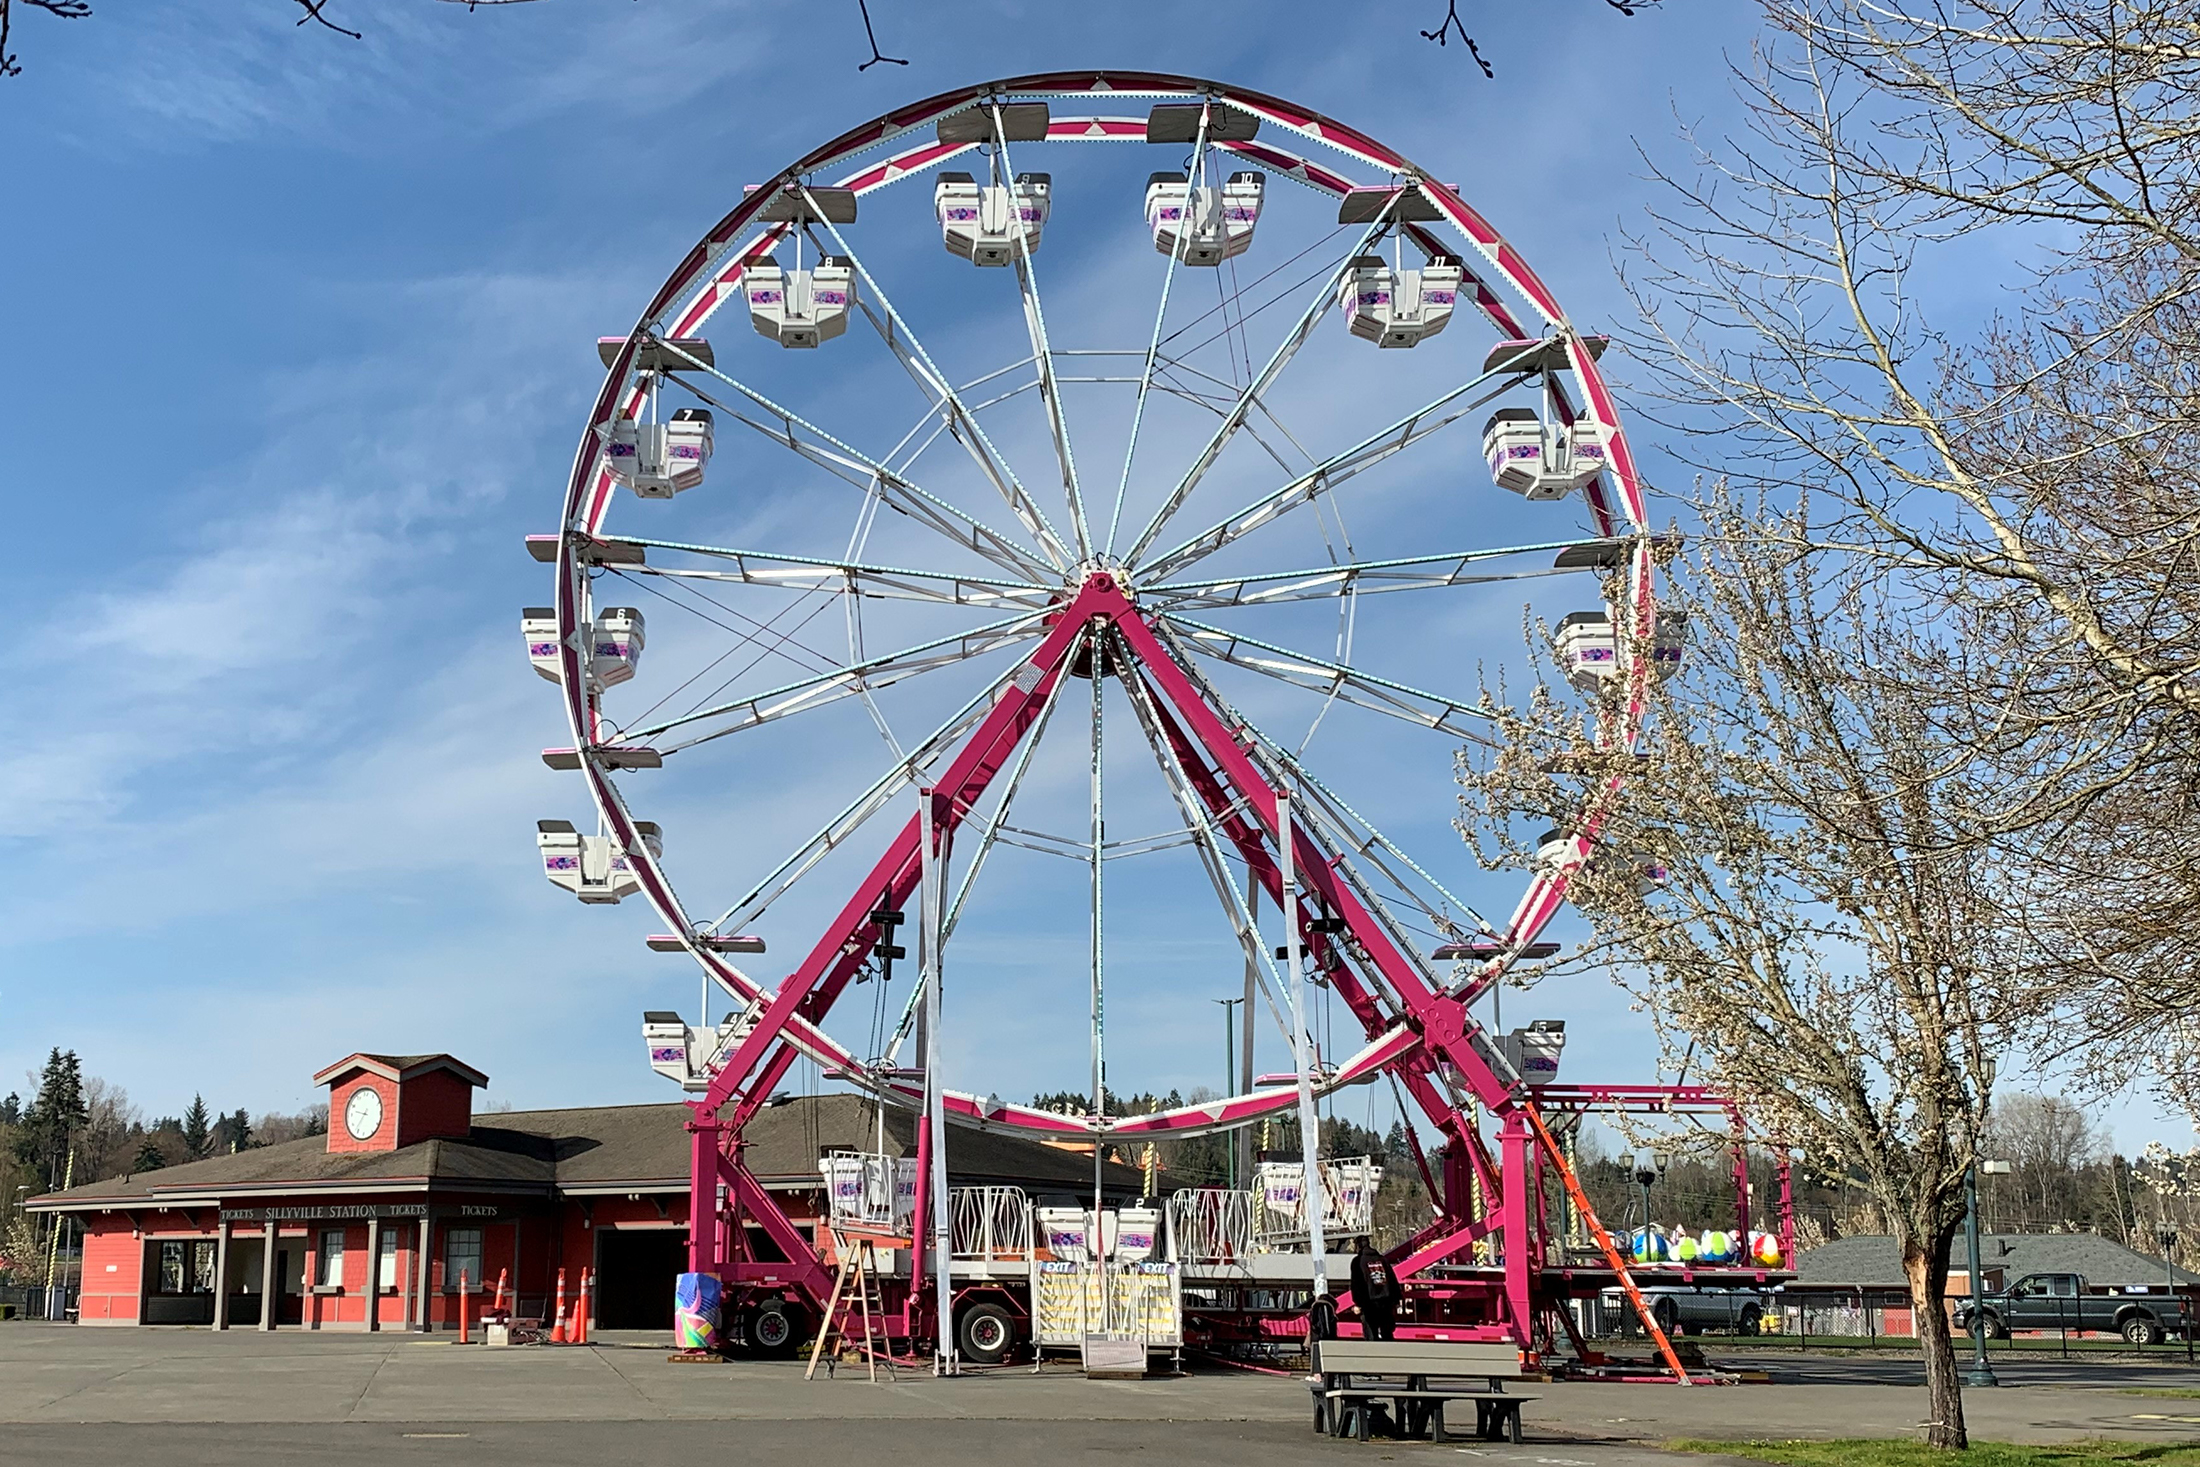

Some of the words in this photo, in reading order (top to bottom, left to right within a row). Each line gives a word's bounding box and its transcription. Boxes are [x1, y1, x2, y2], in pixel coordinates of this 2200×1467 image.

[1022, 174, 1030, 184] 9
[1240, 173, 1254, 184] 10
[825, 257, 833, 267] 8
[1433, 256, 1446, 267] 11
[683, 410, 693, 420] 7
[617, 608, 626, 619] 6
[730, 1013, 738, 1024] 4
[1535, 1022, 1548, 1033] 15
[1135, 1198, 1145, 1209] 2
[221, 1209, 254, 1219] TICKETS
[265, 1206, 323, 1219] SILLYVILLE
[329, 1204, 377, 1218] STATION
[390, 1204, 428, 1215] TICKETS
[461, 1205, 498, 1216] TICKETS
[1046, 1261, 1072, 1273] EXIT
[1144, 1262, 1170, 1274] EXIT
